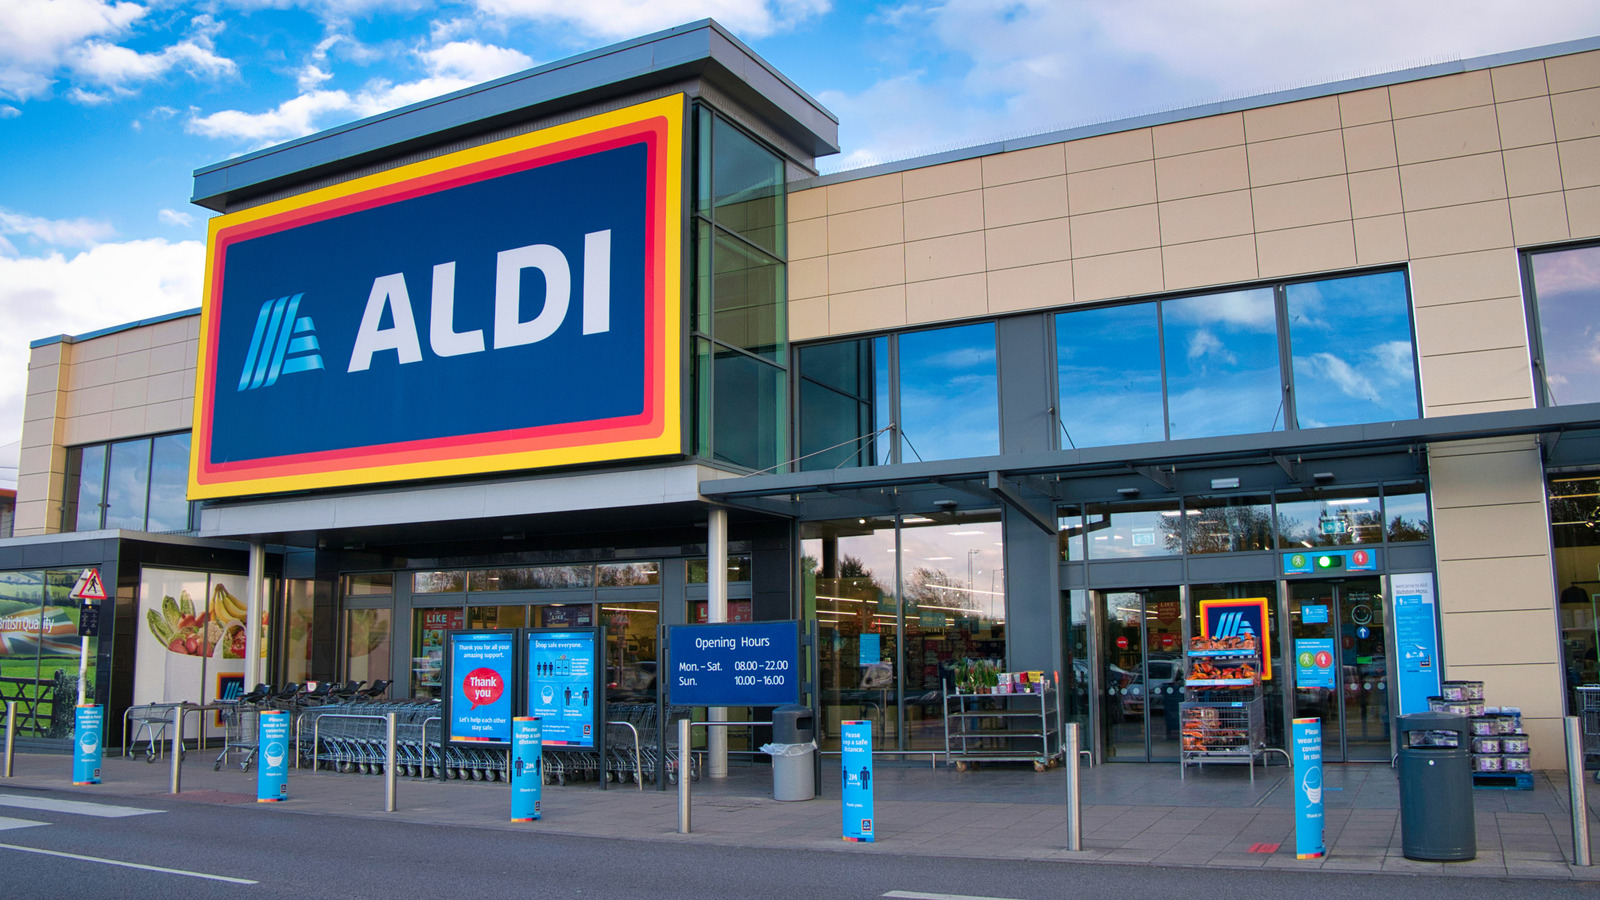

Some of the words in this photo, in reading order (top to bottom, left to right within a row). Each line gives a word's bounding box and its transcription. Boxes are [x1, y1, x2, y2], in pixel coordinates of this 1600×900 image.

[347, 228, 611, 372] ALDI
[427, 614, 447, 623] LIKE
[22, 616, 54, 633] Quaity
[696, 637, 736, 650] Opening
[741, 637, 770, 647] Hours
[679, 662, 699, 671] Mon.
[707, 662, 722, 671] Sat.
[735, 661, 757, 671] 08.00
[765, 660, 788, 670] 22.00
[470, 677, 497, 687] Thank
[679, 676, 698, 686] Sun.
[735, 676, 756, 685] 10.00
[763, 675, 784, 685] 16.00
[475, 689, 491, 700] you
